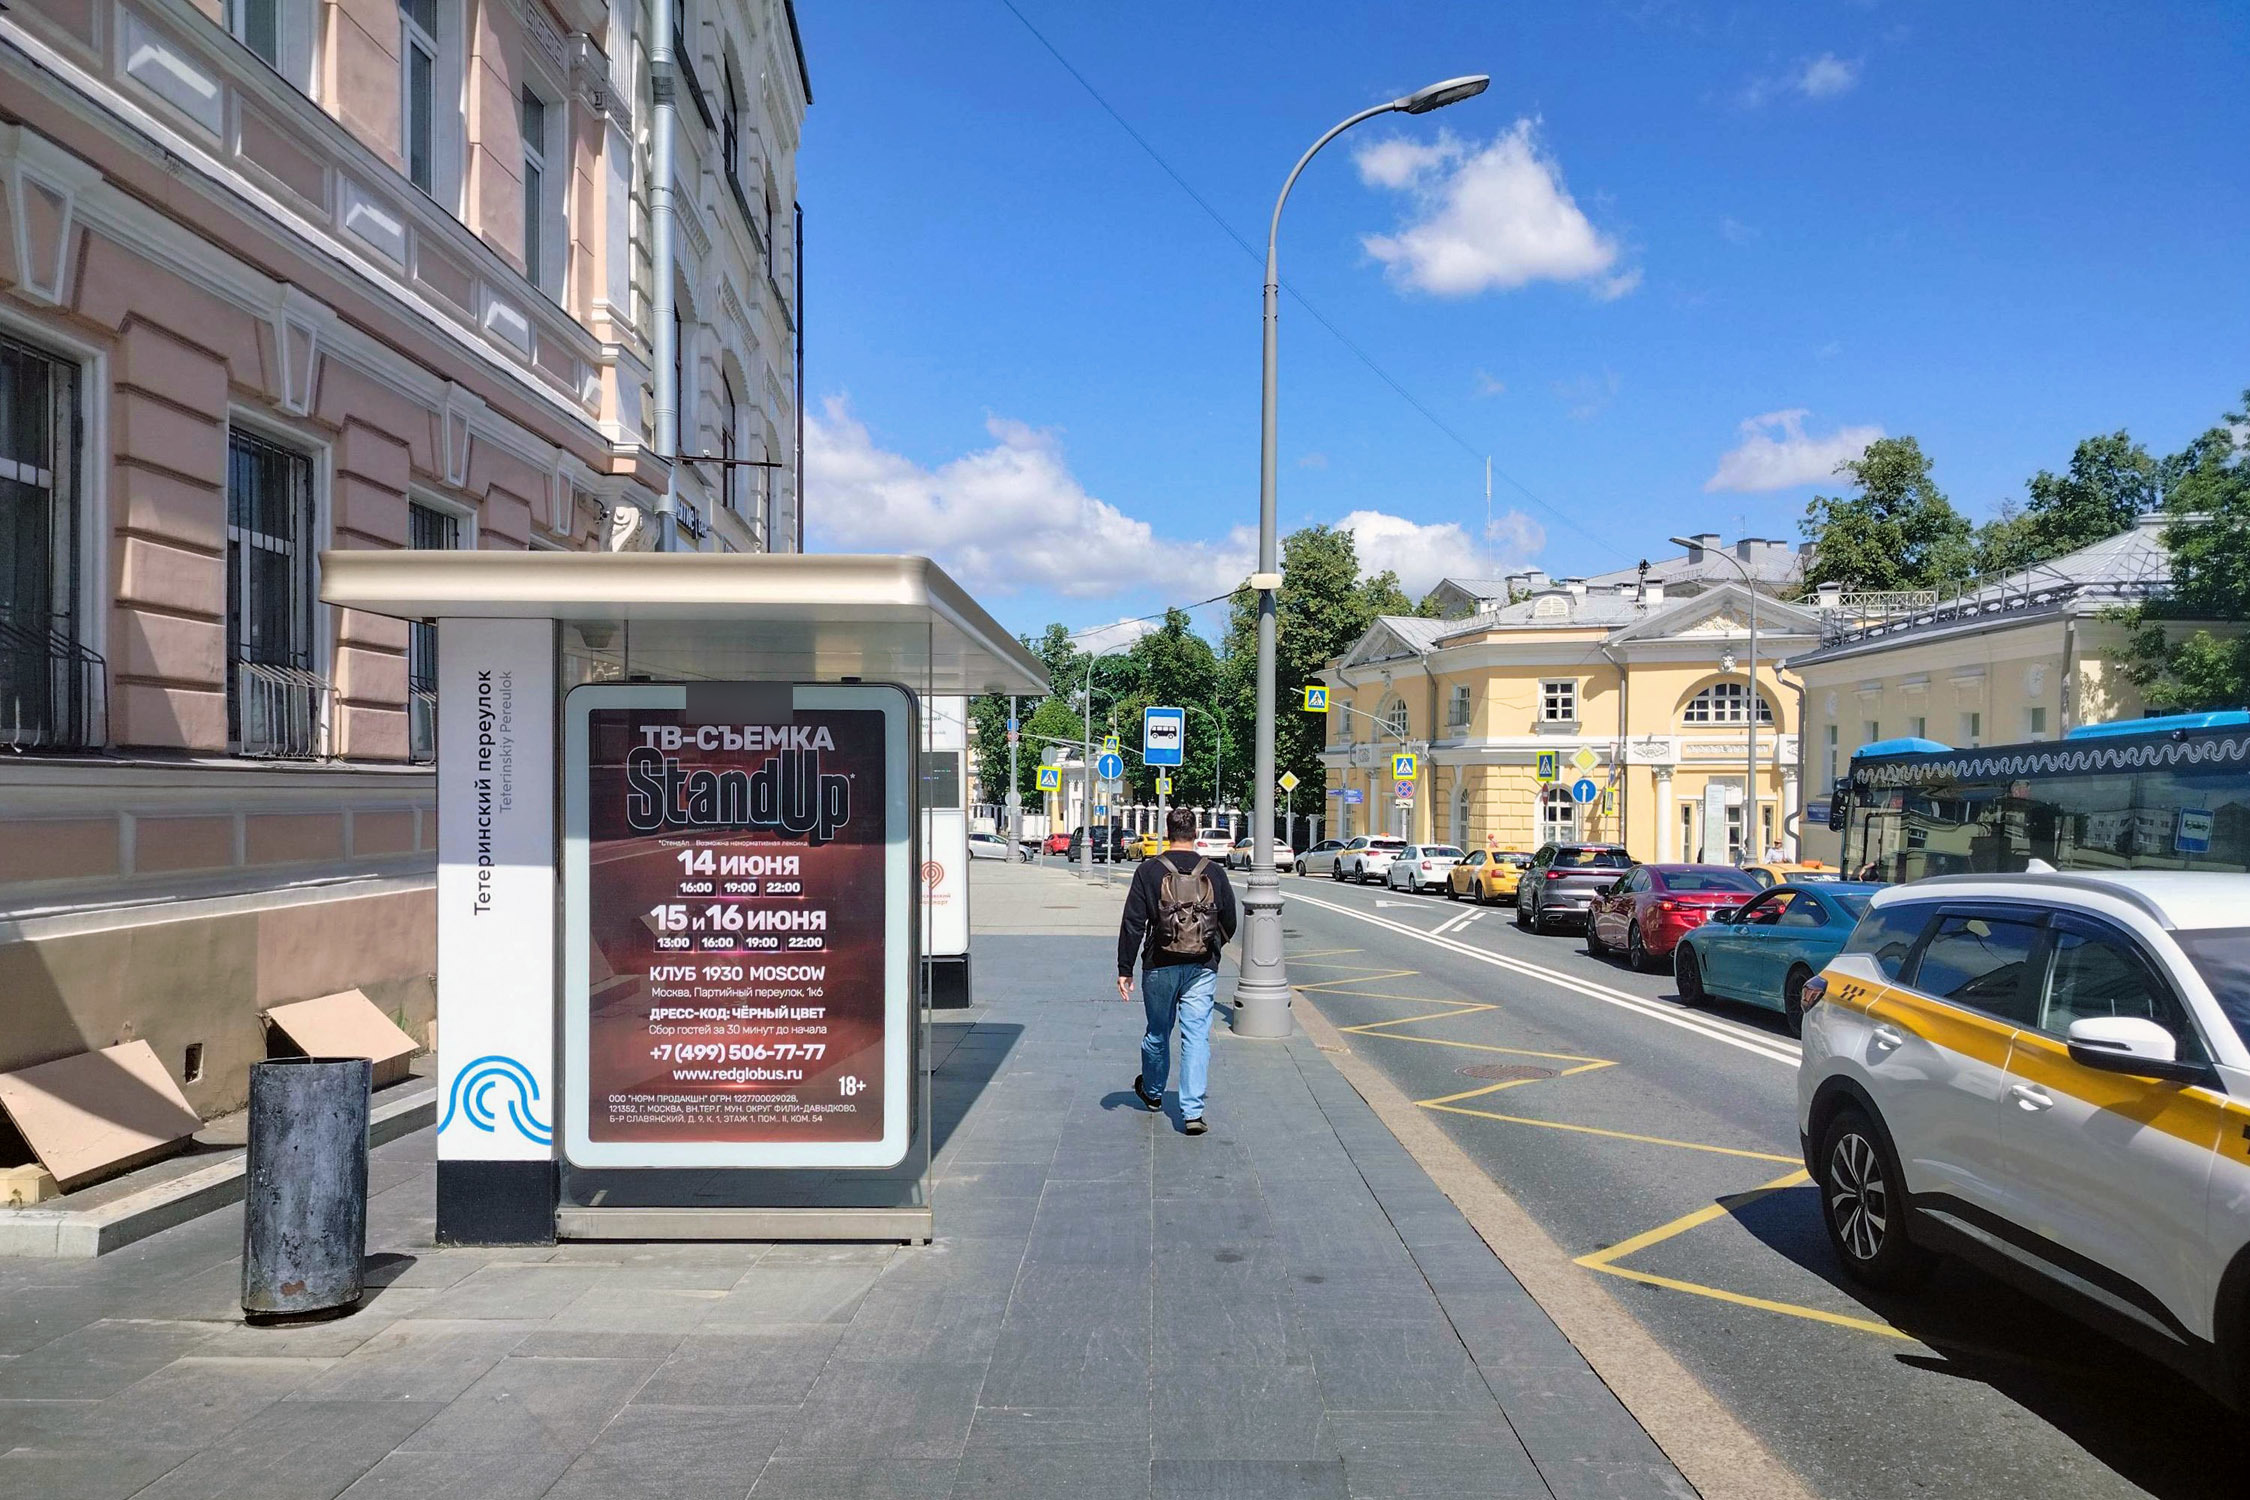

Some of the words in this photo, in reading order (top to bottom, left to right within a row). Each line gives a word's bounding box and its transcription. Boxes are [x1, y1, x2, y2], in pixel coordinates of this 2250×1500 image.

[499, 671, 512, 733] Pereulok
[478, 670, 496, 771] переулок
[639, 724, 835, 750] ТВ-СЪЕМКА
[499, 738, 514, 814] Teterinskiy
[474, 780, 495, 915] Тетеринский
[677, 849, 716, 876] 14
[680, 882, 712, 893] 16:00
[724, 882, 757, 893] 19:00
[766, 882, 800, 893] 22:00
[650, 904, 688, 930] 15
[692, 917, 705, 930] и
[705, 904, 744, 930] 16
[657, 937, 690, 948] 13:00
[701, 937, 734, 948] 16:00
[745, 937, 778, 948] 19:00
[788, 937, 822, 948] 22:00
[650, 966, 696, 981] КЛУБ
[702, 966, 743, 981] 1930
[750, 966, 826, 981] MOSCOW
[652, 987, 692, 998] Москва,
[694, 987, 753, 998] Партийный
[754, 990, 804, 998] переулок,
[806, 987, 823, 998] 1к6
[650, 1008, 730, 1020] ДРЕСС-КОД:
[732, 1005, 790, 1019] ЧЁРНЫЙ
[790, 1008, 826, 1020] ЦВЕТ
[649, 1025, 675, 1036] Сбор
[676, 1024, 711, 1034] гостей
[713, 1026, 726, 1034] за
[726, 1024, 740, 1034] 30
[742, 1026, 774, 1036] минут
[776, 1026, 788, 1036] до
[792, 1026, 827, 1034] начала
[650, 1044, 672, 1060] +7
[674, 1043, 726, 1063] (499)
[728, 1044, 826, 1060] 506-77-77
[673, 1068, 802, 1083] www.redglobus.ru
[838, 1076, 866, 1096] 18+
[608, 1094, 626, 1102] ООО
[710, 1094, 732, 1102] ОГРН
